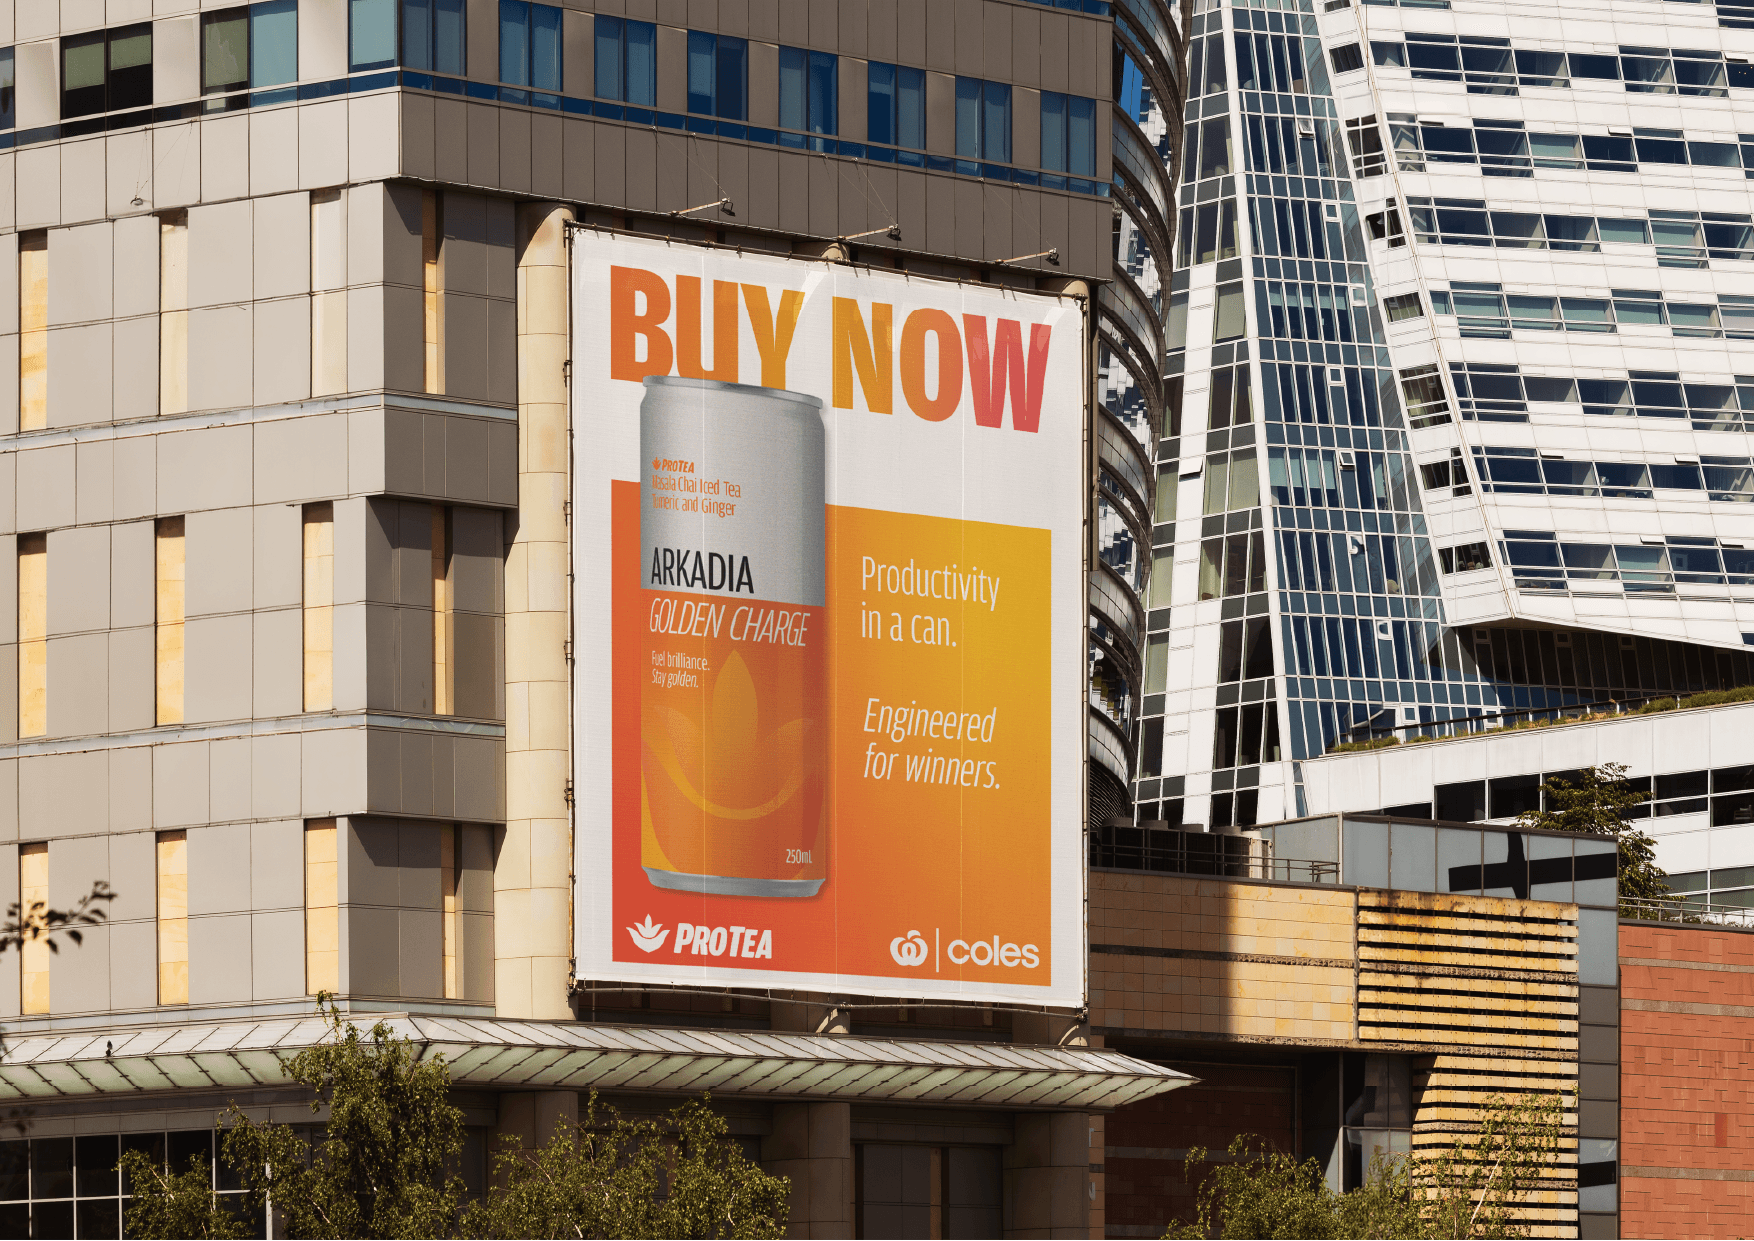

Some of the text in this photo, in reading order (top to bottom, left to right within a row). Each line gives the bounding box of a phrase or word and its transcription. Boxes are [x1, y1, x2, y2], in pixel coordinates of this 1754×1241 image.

[610, 265, 1052, 433] BUY NOW
[661, 458, 695, 474] PROTEA
[678, 475, 697, 493] Chai
[700, 478, 720, 496] Iced
[723, 481, 741, 499] Tea
[681, 496, 698, 512] and
[701, 498, 736, 518] Ginger
[651, 547, 754, 594] ARKADIA
[862, 556, 1000, 611] Productivity
[650, 598, 811, 646] GOLDEN CHARGE
[861, 601, 957, 647] in a can.
[651, 650, 710, 671] Fuel brilliance.
[651, 668, 699, 688] Stay golden.
[863, 697, 997, 743] Engineered
[863, 742, 1000, 789] for winners.
[673, 922, 772, 959] PROTEA
[947, 935, 1040, 969] coles
